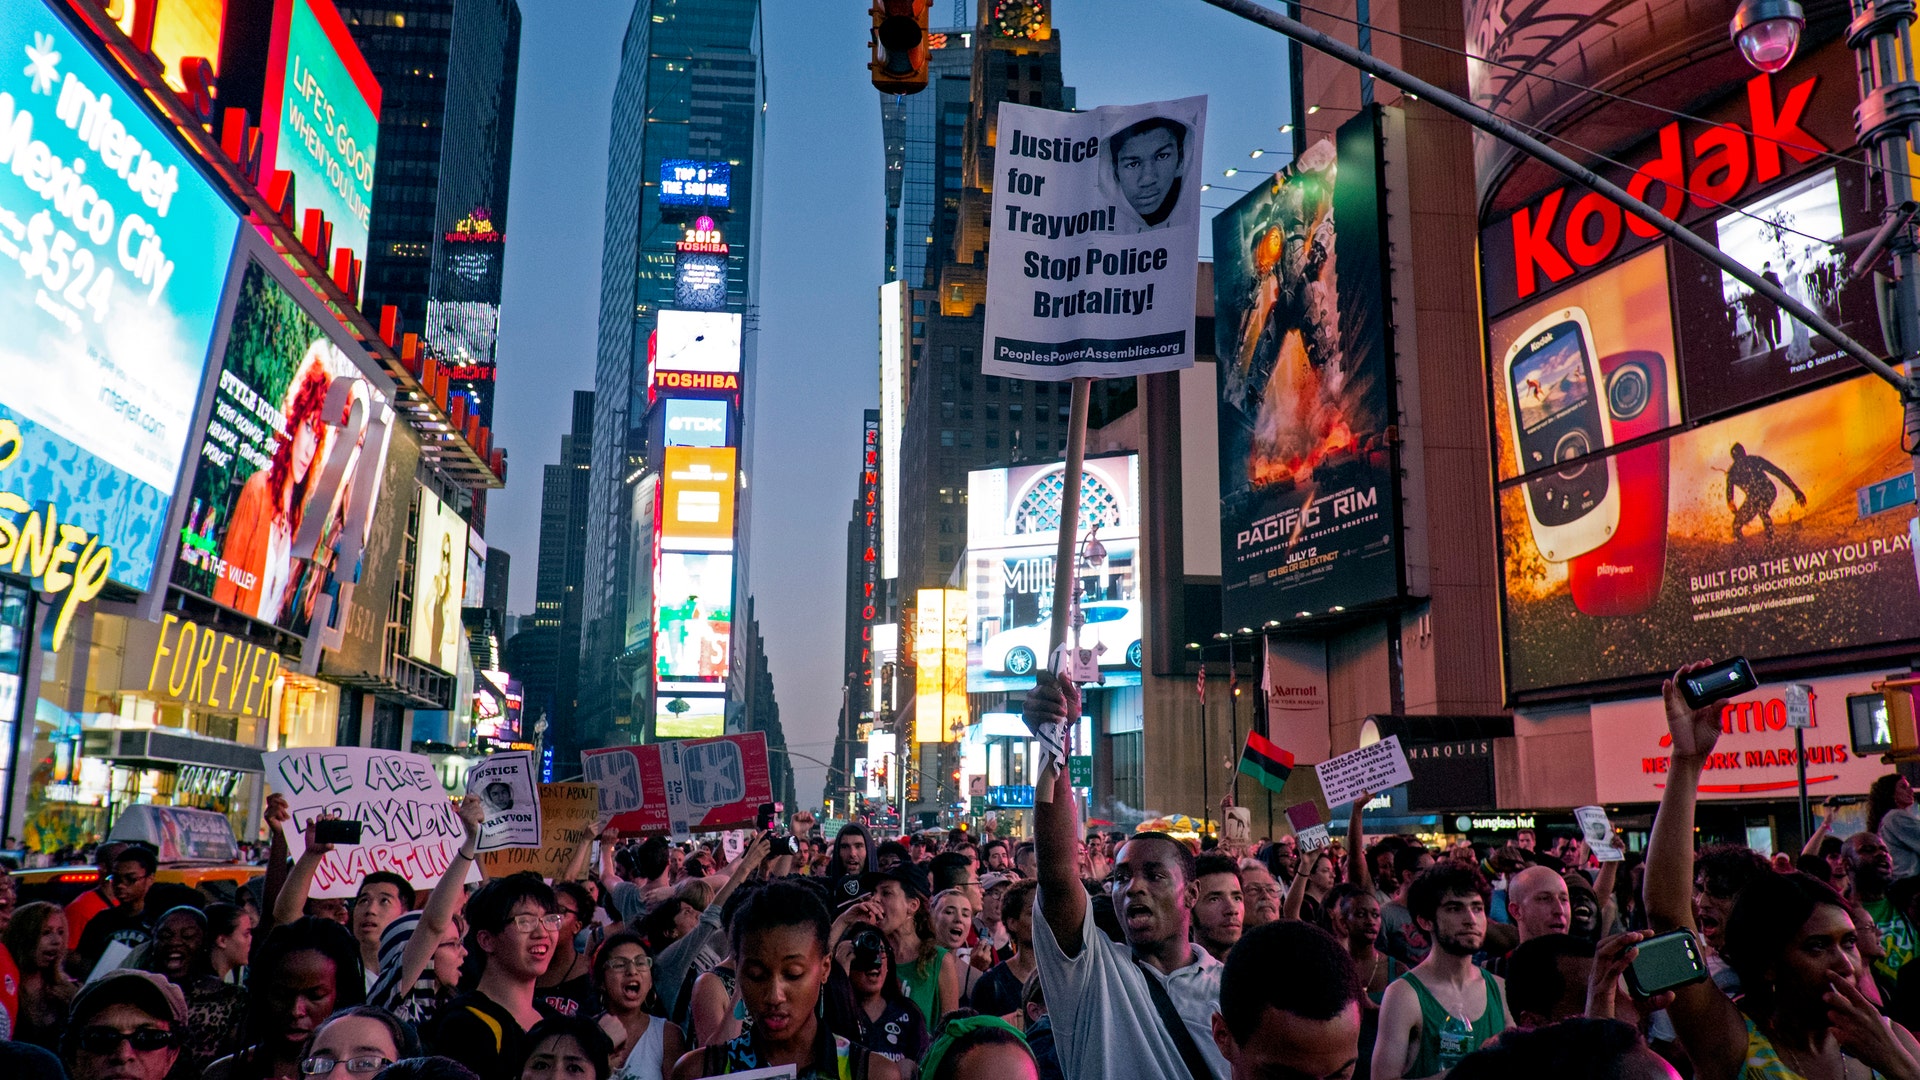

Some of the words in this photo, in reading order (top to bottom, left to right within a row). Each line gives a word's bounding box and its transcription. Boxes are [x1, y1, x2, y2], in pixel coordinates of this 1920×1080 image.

[294, 56, 335, 136] LIFE'S
[337, 125, 373, 192] GOOD
[1010, 129, 1099, 163] Justice
[290, 98, 324, 168] WHEN
[325, 159, 348, 198] YOU
[348, 189, 371, 231] LIVE
[1008, 167, 1046, 197] for
[1511, 73, 1831, 299] Kodak
[1006, 204, 1117, 240] Trayvon!
[677, 242, 728, 253] TOSHIBA
[685, 230, 721, 243] 2013
[118, 214, 174, 307] City
[1023, 250, 1081, 282] Stop
[1085, 247, 1168, 276] Police
[1033, 283, 1155, 319] Brutality!
[999, 342, 1180, 363] PeoplesPowerAssemblies.org
[1530, 332, 1553, 352] Kodak
[219, 369, 258, 412] STYLE
[656, 372, 738, 389] TOSHIBA
[681, 417, 722, 431] TDK
[864, 430, 877, 526] ERNST
[1875, 485, 1887, 509] 7
[1897, 478, 1909, 491] AV
[1237, 506, 1320, 550] PACIFIC
[1333, 486, 1377, 518] RIM
[1310, 525, 1340, 539] CREATED
[1342, 512, 1379, 529] MONSTERS
[864, 547, 875, 562] &
[1267, 568, 1277, 578] GO
[1277, 565, 1288, 575] BIG
[1289, 562, 1298, 572] OR
[1299, 559, 1309, 569] GO
[1310, 550, 1339, 567] EXTINCT
[1286, 549, 1307, 564] JULY
[1308, 546, 1317, 558] 12
[1690, 570, 1726, 591] BUILT
[1730, 565, 1758, 584] FOR
[1761, 558, 1790, 576] THE
[1792, 550, 1829, 570] WAY
[1832, 542, 1868, 563] YOU
[1872, 533, 1913, 556] PLAY
[209, 556, 225, 577] THE
[229, 564, 257, 591] VALLEY
[1691, 586, 1751, 606] WATERPROOF.
[1752, 573, 1817, 595] SHOCKPROOF.
[1818, 561, 1882, 583] DUSTPROOF.
[1693, 593, 1816, 622] www.kodak.com/go/videocameras
[148, 613, 280, 718] FOREVER
[1272, 685, 1316, 697] Marriott
[1320, 743, 1381, 770] VIGILANTES
[1321, 744, 1396, 775] MISOGYNISTS:
[1409, 742, 1488, 760] MARQUIS
[279, 753, 352, 794] WE
[366, 755, 432, 791] ARE
[475, 766, 518, 782] JUSTICE
[1323, 773, 1339, 782] We
[1342, 766, 1358, 775] are
[1360, 752, 1393, 768] united
[1337, 770, 1366, 785] anger
[1379, 761, 1395, 769] we
[1642, 757, 1671, 774] NE
[176, 765, 231, 797] FOREVER
[567, 787, 596, 800] ABOUT
[673, 780, 683, 794] 20
[1327, 787, 1345, 796] too
[1347, 778, 1365, 789] will
[1366, 768, 1396, 781] stand
[1330, 793, 1347, 803] our
[1349, 779, 1389, 798] ground.
[565, 808, 598, 820] GROUND
[641, 823, 668, 831] LASKO
[1472, 816, 1516, 832] sunglass
[1517, 815, 1536, 829] hut
[484, 851, 498, 864] IN
[508, 848, 540, 863] YOUR
[545, 847, 572, 863] CAR
[1301, 835, 1331, 850] Man
[313, 840, 456, 890] MARTIN
